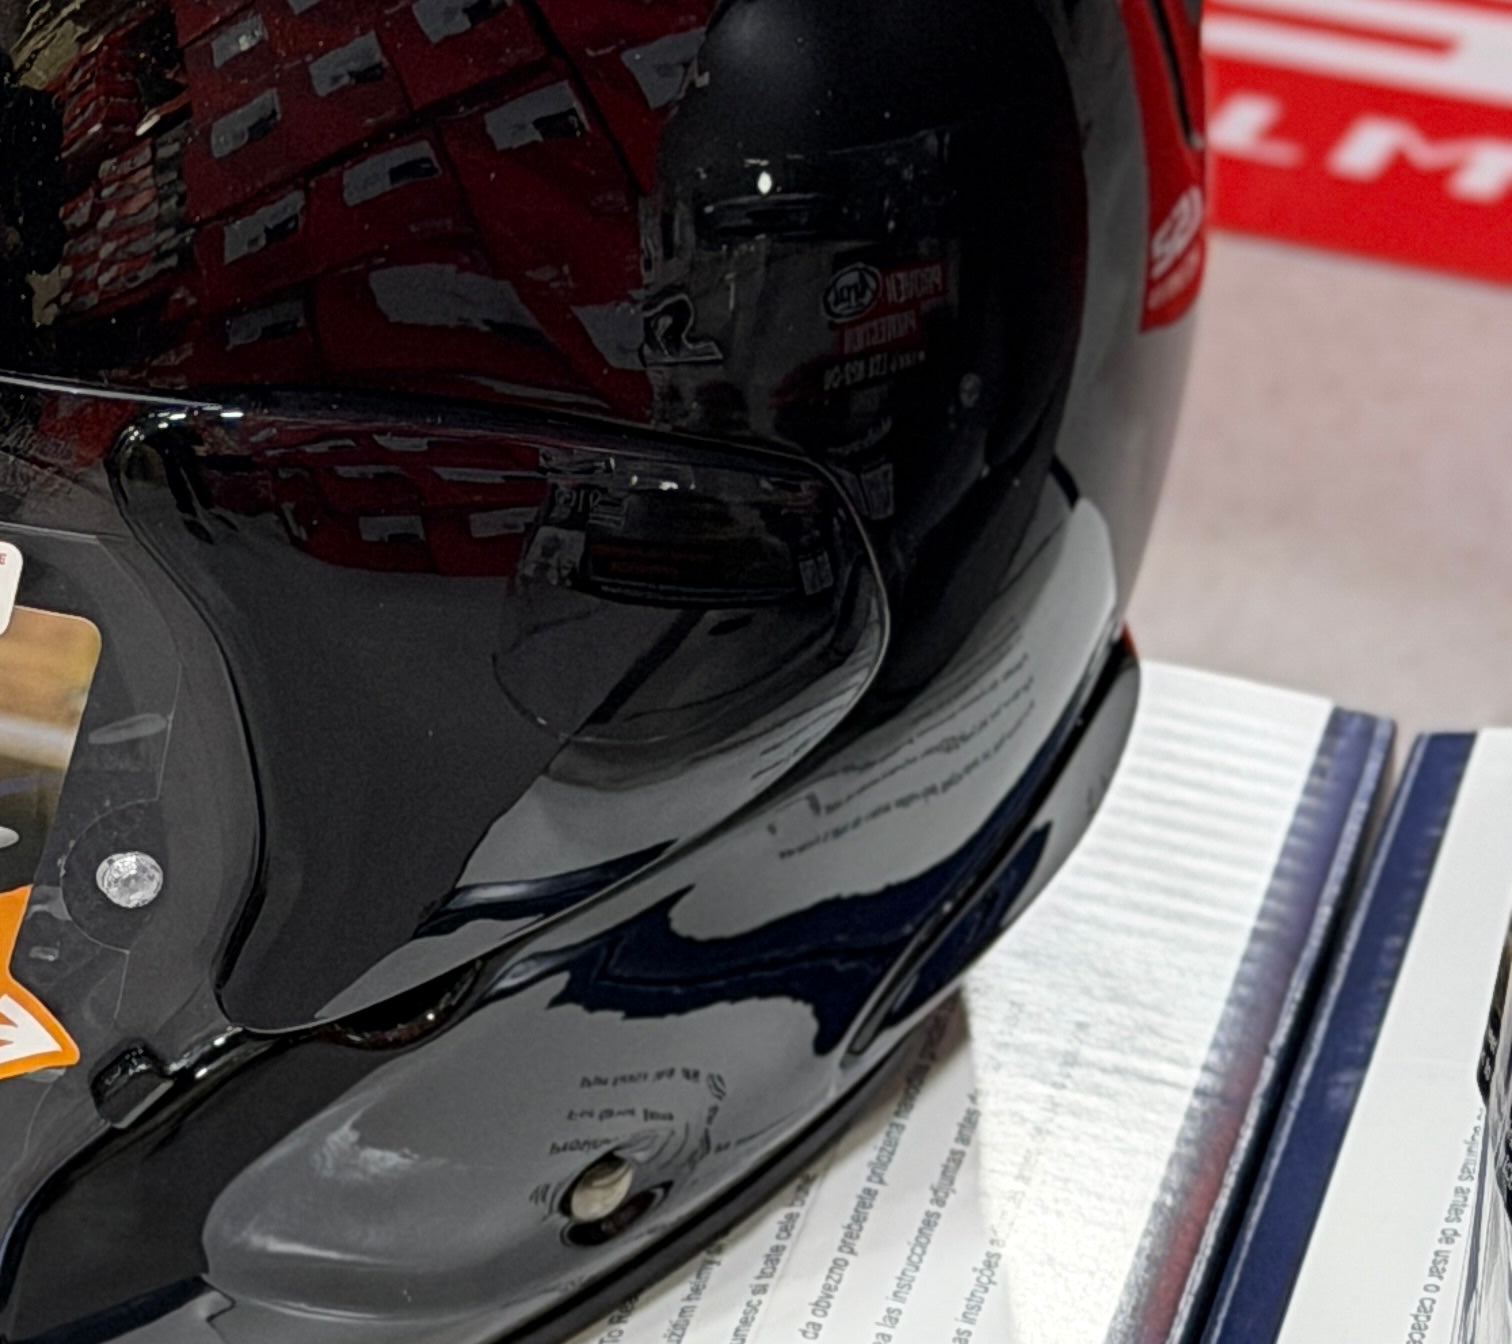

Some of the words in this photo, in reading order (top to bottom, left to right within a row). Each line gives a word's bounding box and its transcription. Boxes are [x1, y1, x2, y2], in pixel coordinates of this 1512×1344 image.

[838, 1187, 878, 1256] preberete
[876, 1307, 902, 1328] las
[893, 1209, 942, 1303] instrucciones
[930, 1148, 966, 1208] adjuntas
[955, 1108, 980, 1146] antes
[1444, 1185, 1471, 1224] antes
[776, 1206, 800, 1240] cele
[1438, 1229, 1461, 1245] de
[755, 1244, 786, 1280] toate
[1428, 1250, 1451, 1280] usar
[750, 1278, 769, 1296] si
[810, 1257, 849, 1317] obvezno
[1423, 1284, 1440, 1293] o
[799, 1321, 822, 1339] da
